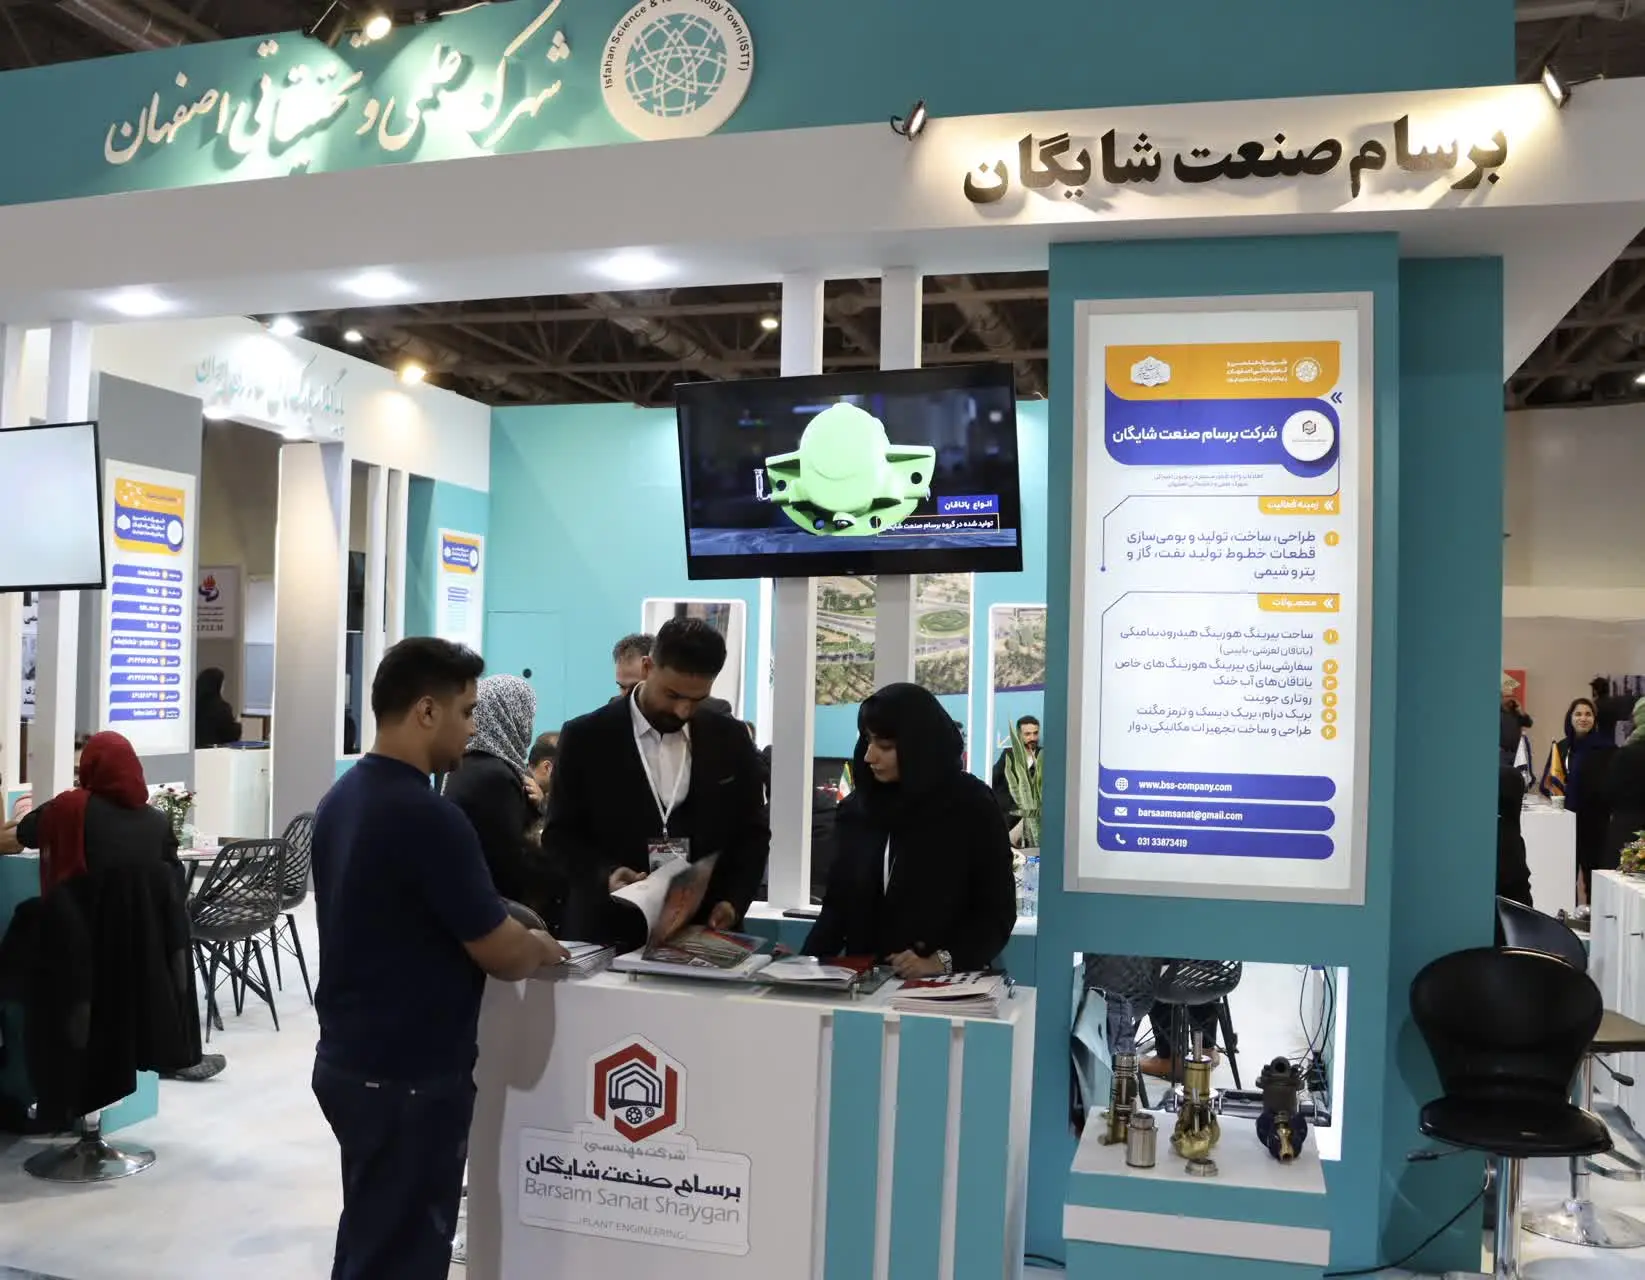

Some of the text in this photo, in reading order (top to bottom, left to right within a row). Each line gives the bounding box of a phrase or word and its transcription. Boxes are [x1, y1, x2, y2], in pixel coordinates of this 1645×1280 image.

[602, 45, 617, 90] Isfahan
[611, 5, 648, 45] Science
[721, 7, 745, 36] Town
[735, 35, 750, 72] (ISTT)
[104, 71, 230, 165] اصفهان
[355, 98, 380, 135] و
[963, 114, 1508, 204] برسام صنعت شایگان
[1112, 425, 1278, 444] شرکت برسام صنعت شایگان
[972, 499, 993, 510] انواع
[941, 520, 956, 529] گروه
[977, 520, 994, 528] تولید
[1188, 533, 1196, 544] و
[1197, 530, 1228, 545] تولید
[1126, 551, 1134, 561] و
[1136, 545, 1152, 561] گاز
[1188, 547, 1222, 562] تولید
[1225, 547, 1266, 562] خطوط
[1270, 546, 1316, 559] قطعات
[1115, 657, 1141, 670] خاص
[1281, 693, 1313, 705] روتاری
[1187, 709, 1194, 719] و
[1285, 709, 1312, 722] بریک
[1270, 727, 1277, 737] و
[1278, 725, 1312, 737] طراحی
[1139, 780, 1233, 793] www.bss-company.com
[1138, 808, 1243, 821] barsaamsanat@gmail.com
[1137, 837, 1150, 846] 031
[583, 1141, 686, 1161] شرکت مهندسی
[526, 1153, 742, 1203] برسام صنعت شایگان
[524, 1177, 740, 1225] Barsam Sanat Shaygan
[583, 1217, 685, 1240] PLANT ENGINEERING
